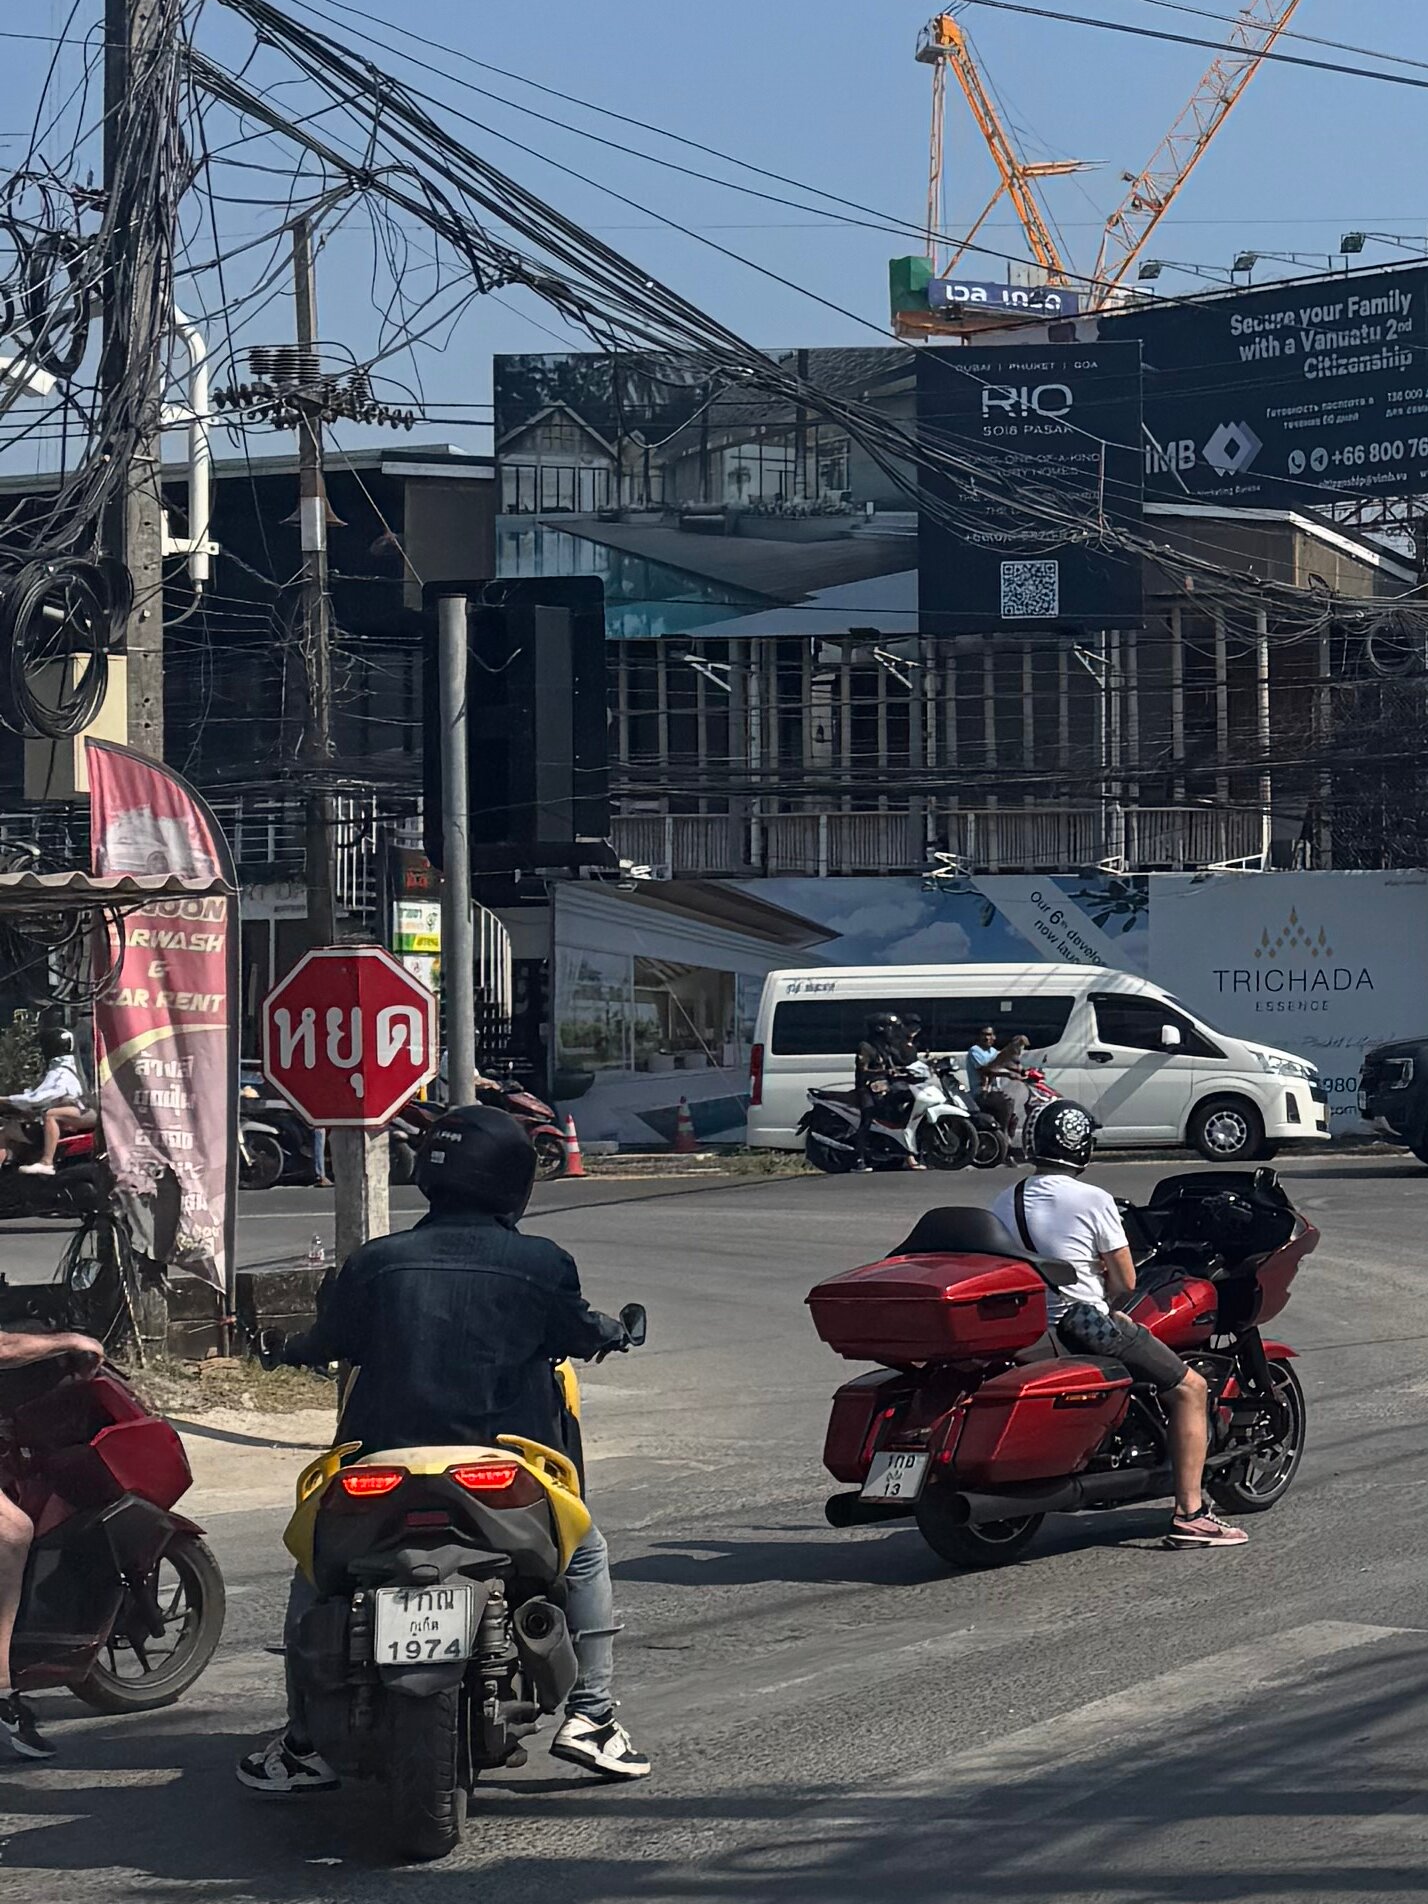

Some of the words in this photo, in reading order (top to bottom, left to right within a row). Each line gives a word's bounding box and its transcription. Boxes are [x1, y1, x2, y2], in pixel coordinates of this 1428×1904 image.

[1230, 310, 1295, 336] Secure
[1300, 302, 1343, 328] your
[1348, 289, 1412, 319] Family
[1239, 334, 1280, 362] with
[1284, 336, 1296, 354] a
[1300, 323, 1381, 352] Vanuatu
[1386, 318, 1412, 340] 2nd
[1074, 361, 1098, 369] GOA
[1304, 345, 1412, 379] Citizenship
[981, 384, 1073, 418] RIO
[1332, 444, 1365, 466] +66
[1369, 439, 1404, 463] 800
[1031, 891, 1051, 913] Our
[1034, 920, 1058, 943] now
[1212, 967, 1375, 993] TRICHADA
[156, 991, 225, 1013] RENT
[1255, 1000, 1329, 1012] ESSENCE
[274, 1005, 423, 1098] หยุด
[884, 1483, 901, 1496] 13
[388, 1638, 460, 1660] 1974
